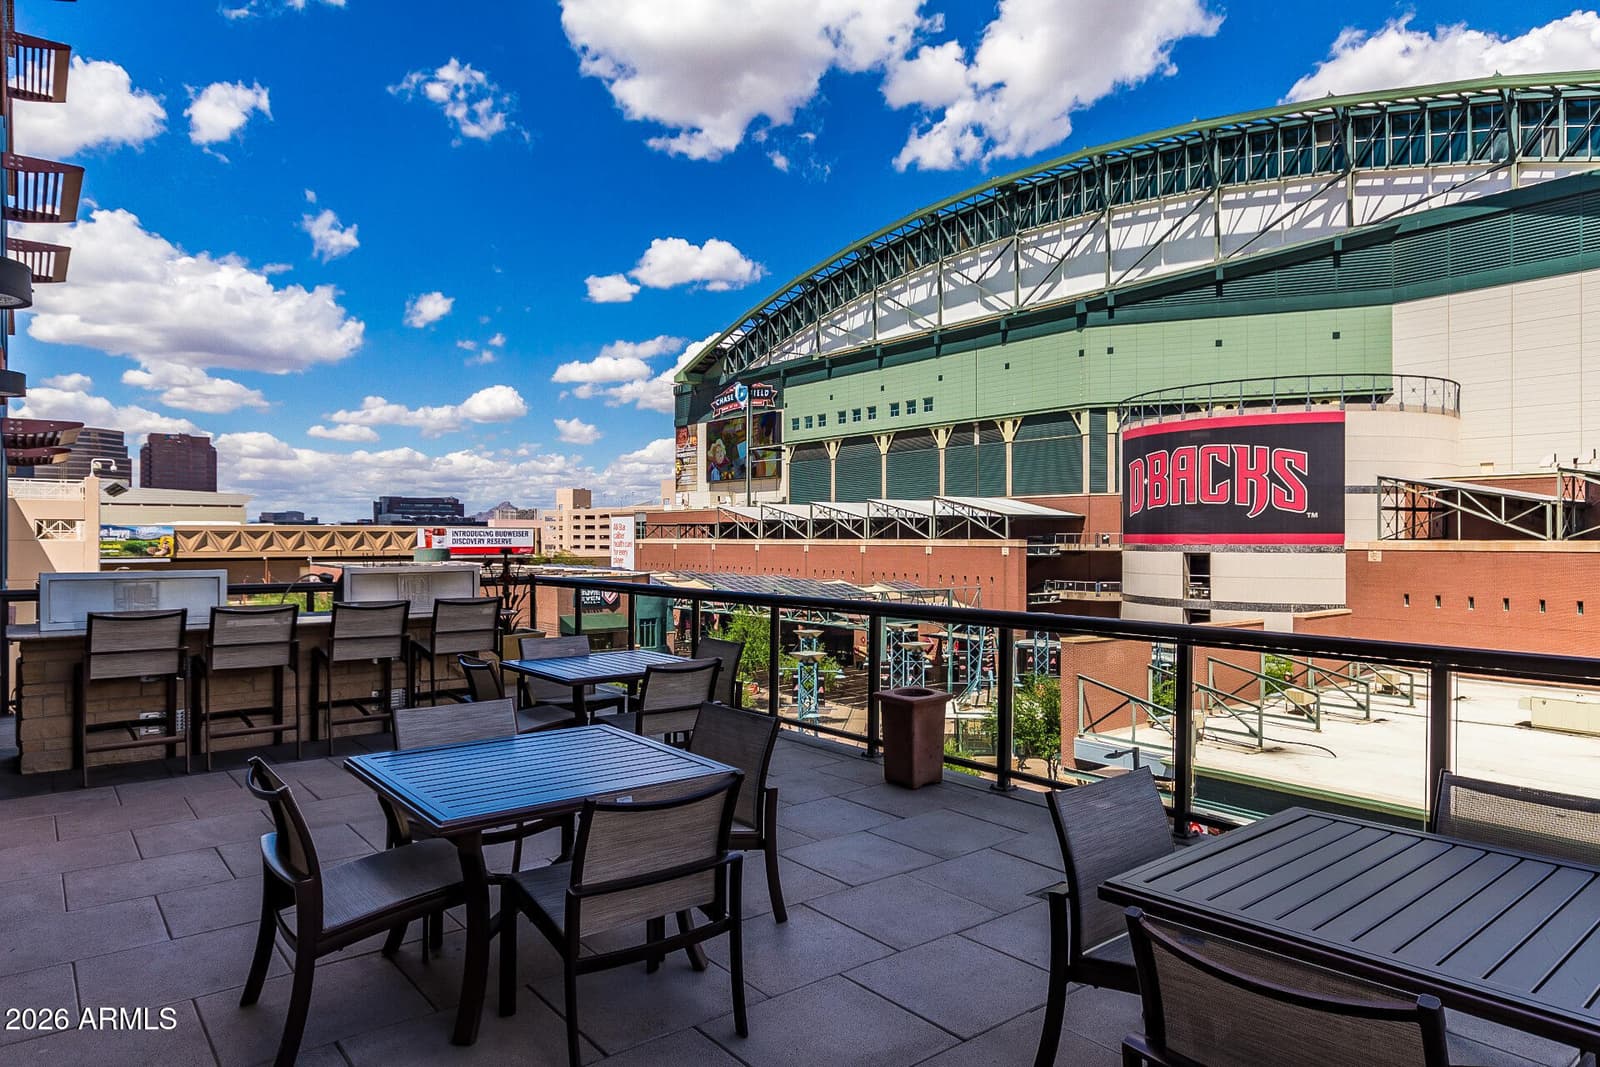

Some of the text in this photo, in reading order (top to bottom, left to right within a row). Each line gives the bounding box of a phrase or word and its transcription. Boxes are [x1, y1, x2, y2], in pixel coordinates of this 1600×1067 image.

[715, 394, 734, 406] CHASE
[751, 389, 770, 397] IELD
[451, 530, 529, 538] INTRODUCING BUDWEISER
[451, 537, 486, 545] DISCOVERY
